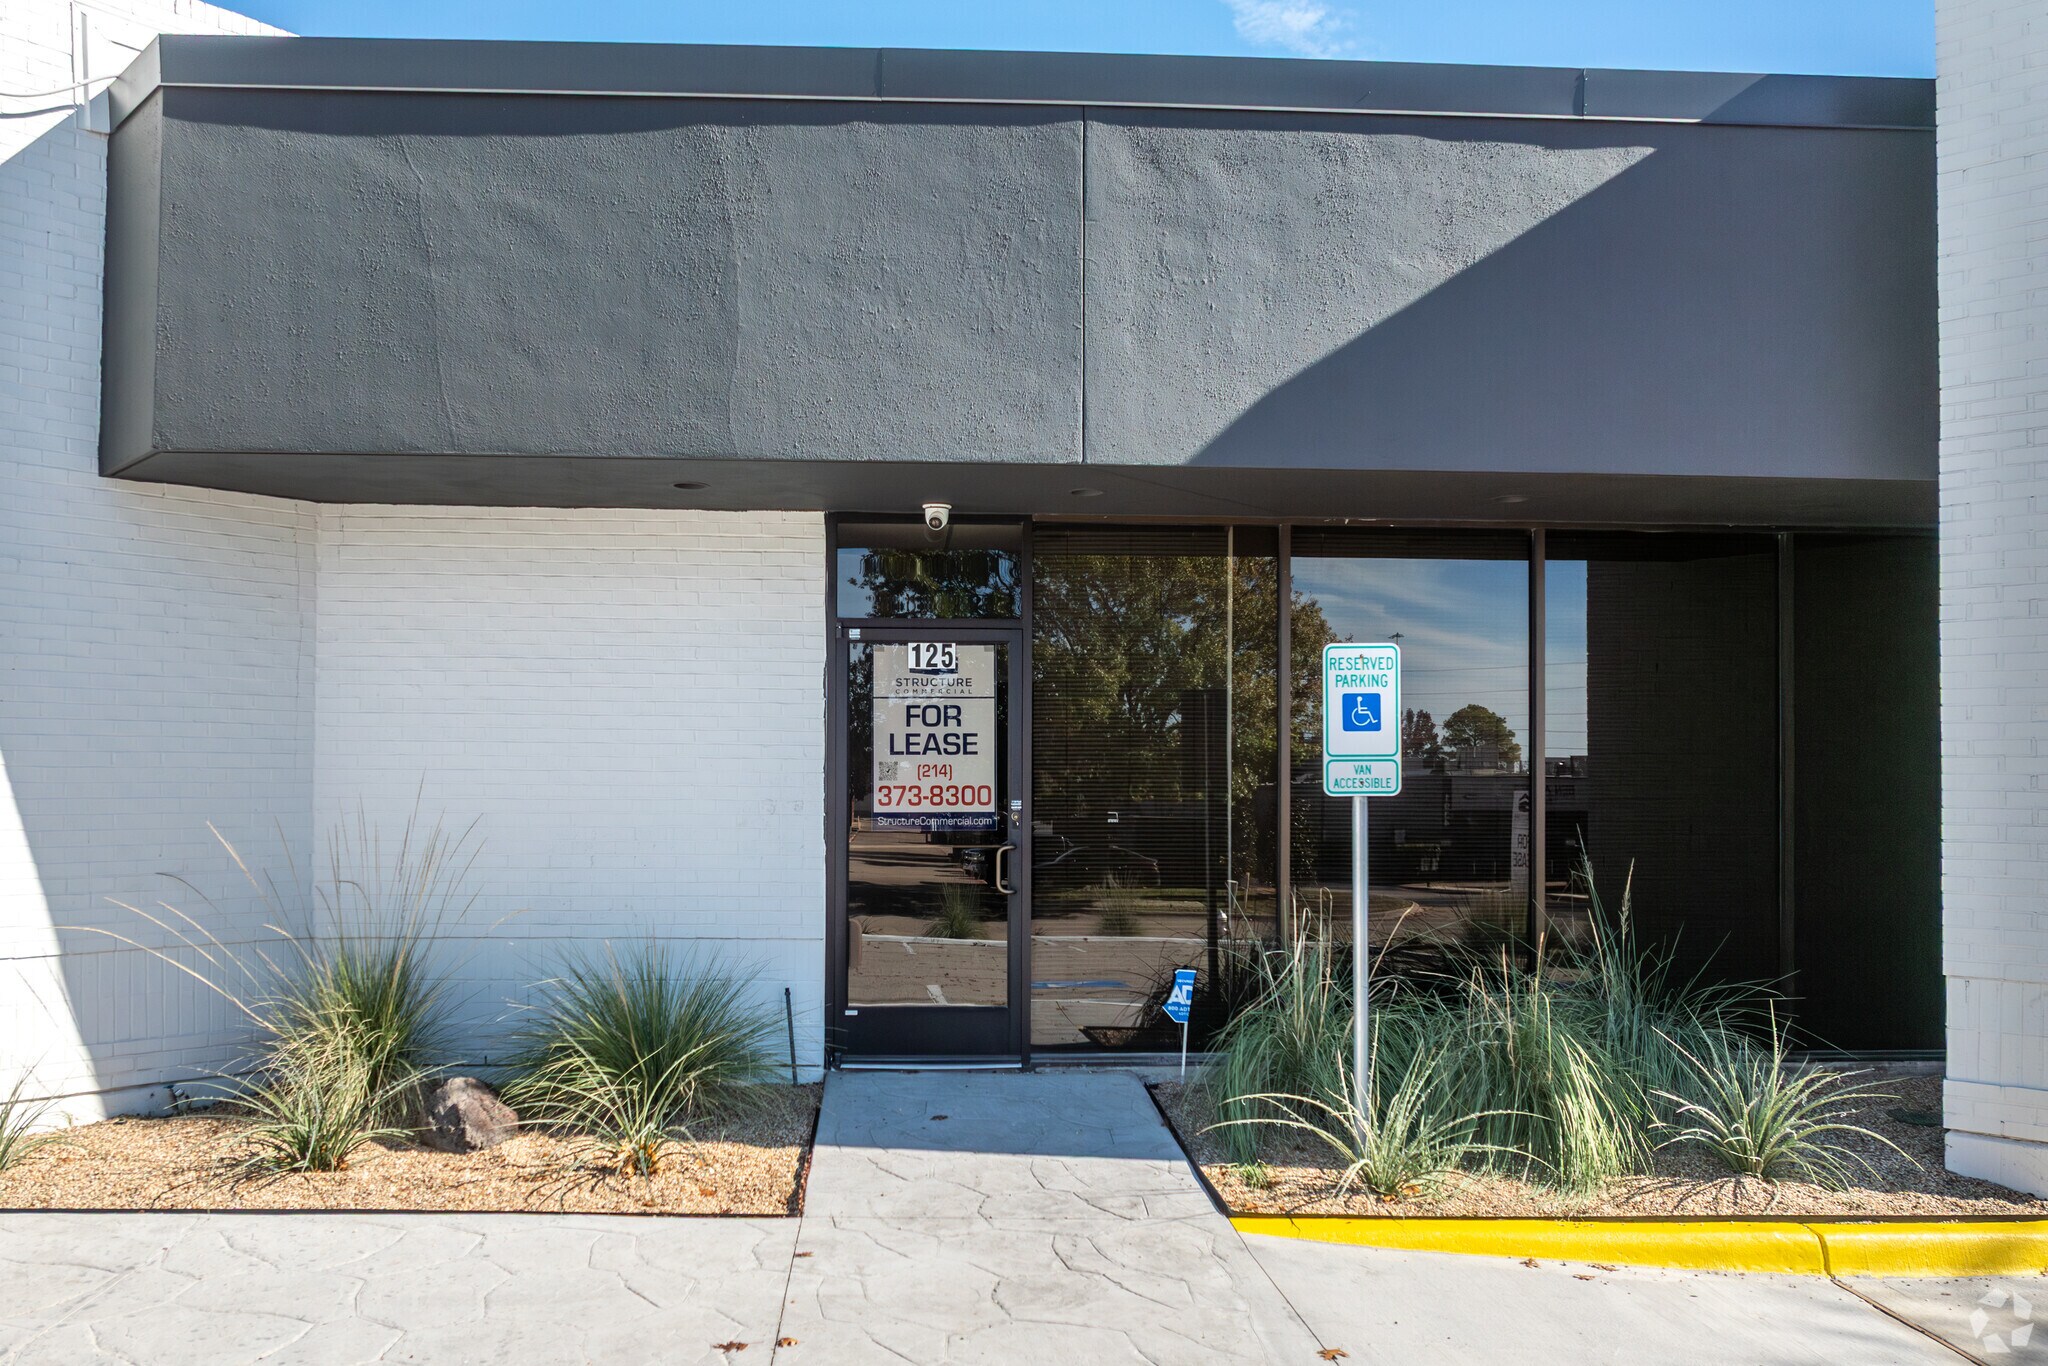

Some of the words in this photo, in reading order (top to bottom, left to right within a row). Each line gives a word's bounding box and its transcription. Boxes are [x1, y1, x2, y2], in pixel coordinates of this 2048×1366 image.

[911, 643, 954, 668] 125
[1329, 656, 1394, 671] RESERVED
[895, 677, 973, 688] STRUCTURE
[1335, 674, 1389, 688] PARKING
[905, 704, 962, 727] FOR
[889, 733, 978, 756] LEASE
[917, 763, 953, 781] (214)
[1353, 764, 1372, 775] VAN
[1333, 777, 1392, 789] ACCESSIBLE
[877, 784, 992, 807] 373-8300
[877, 816, 993, 827] StructureCommercial.com
